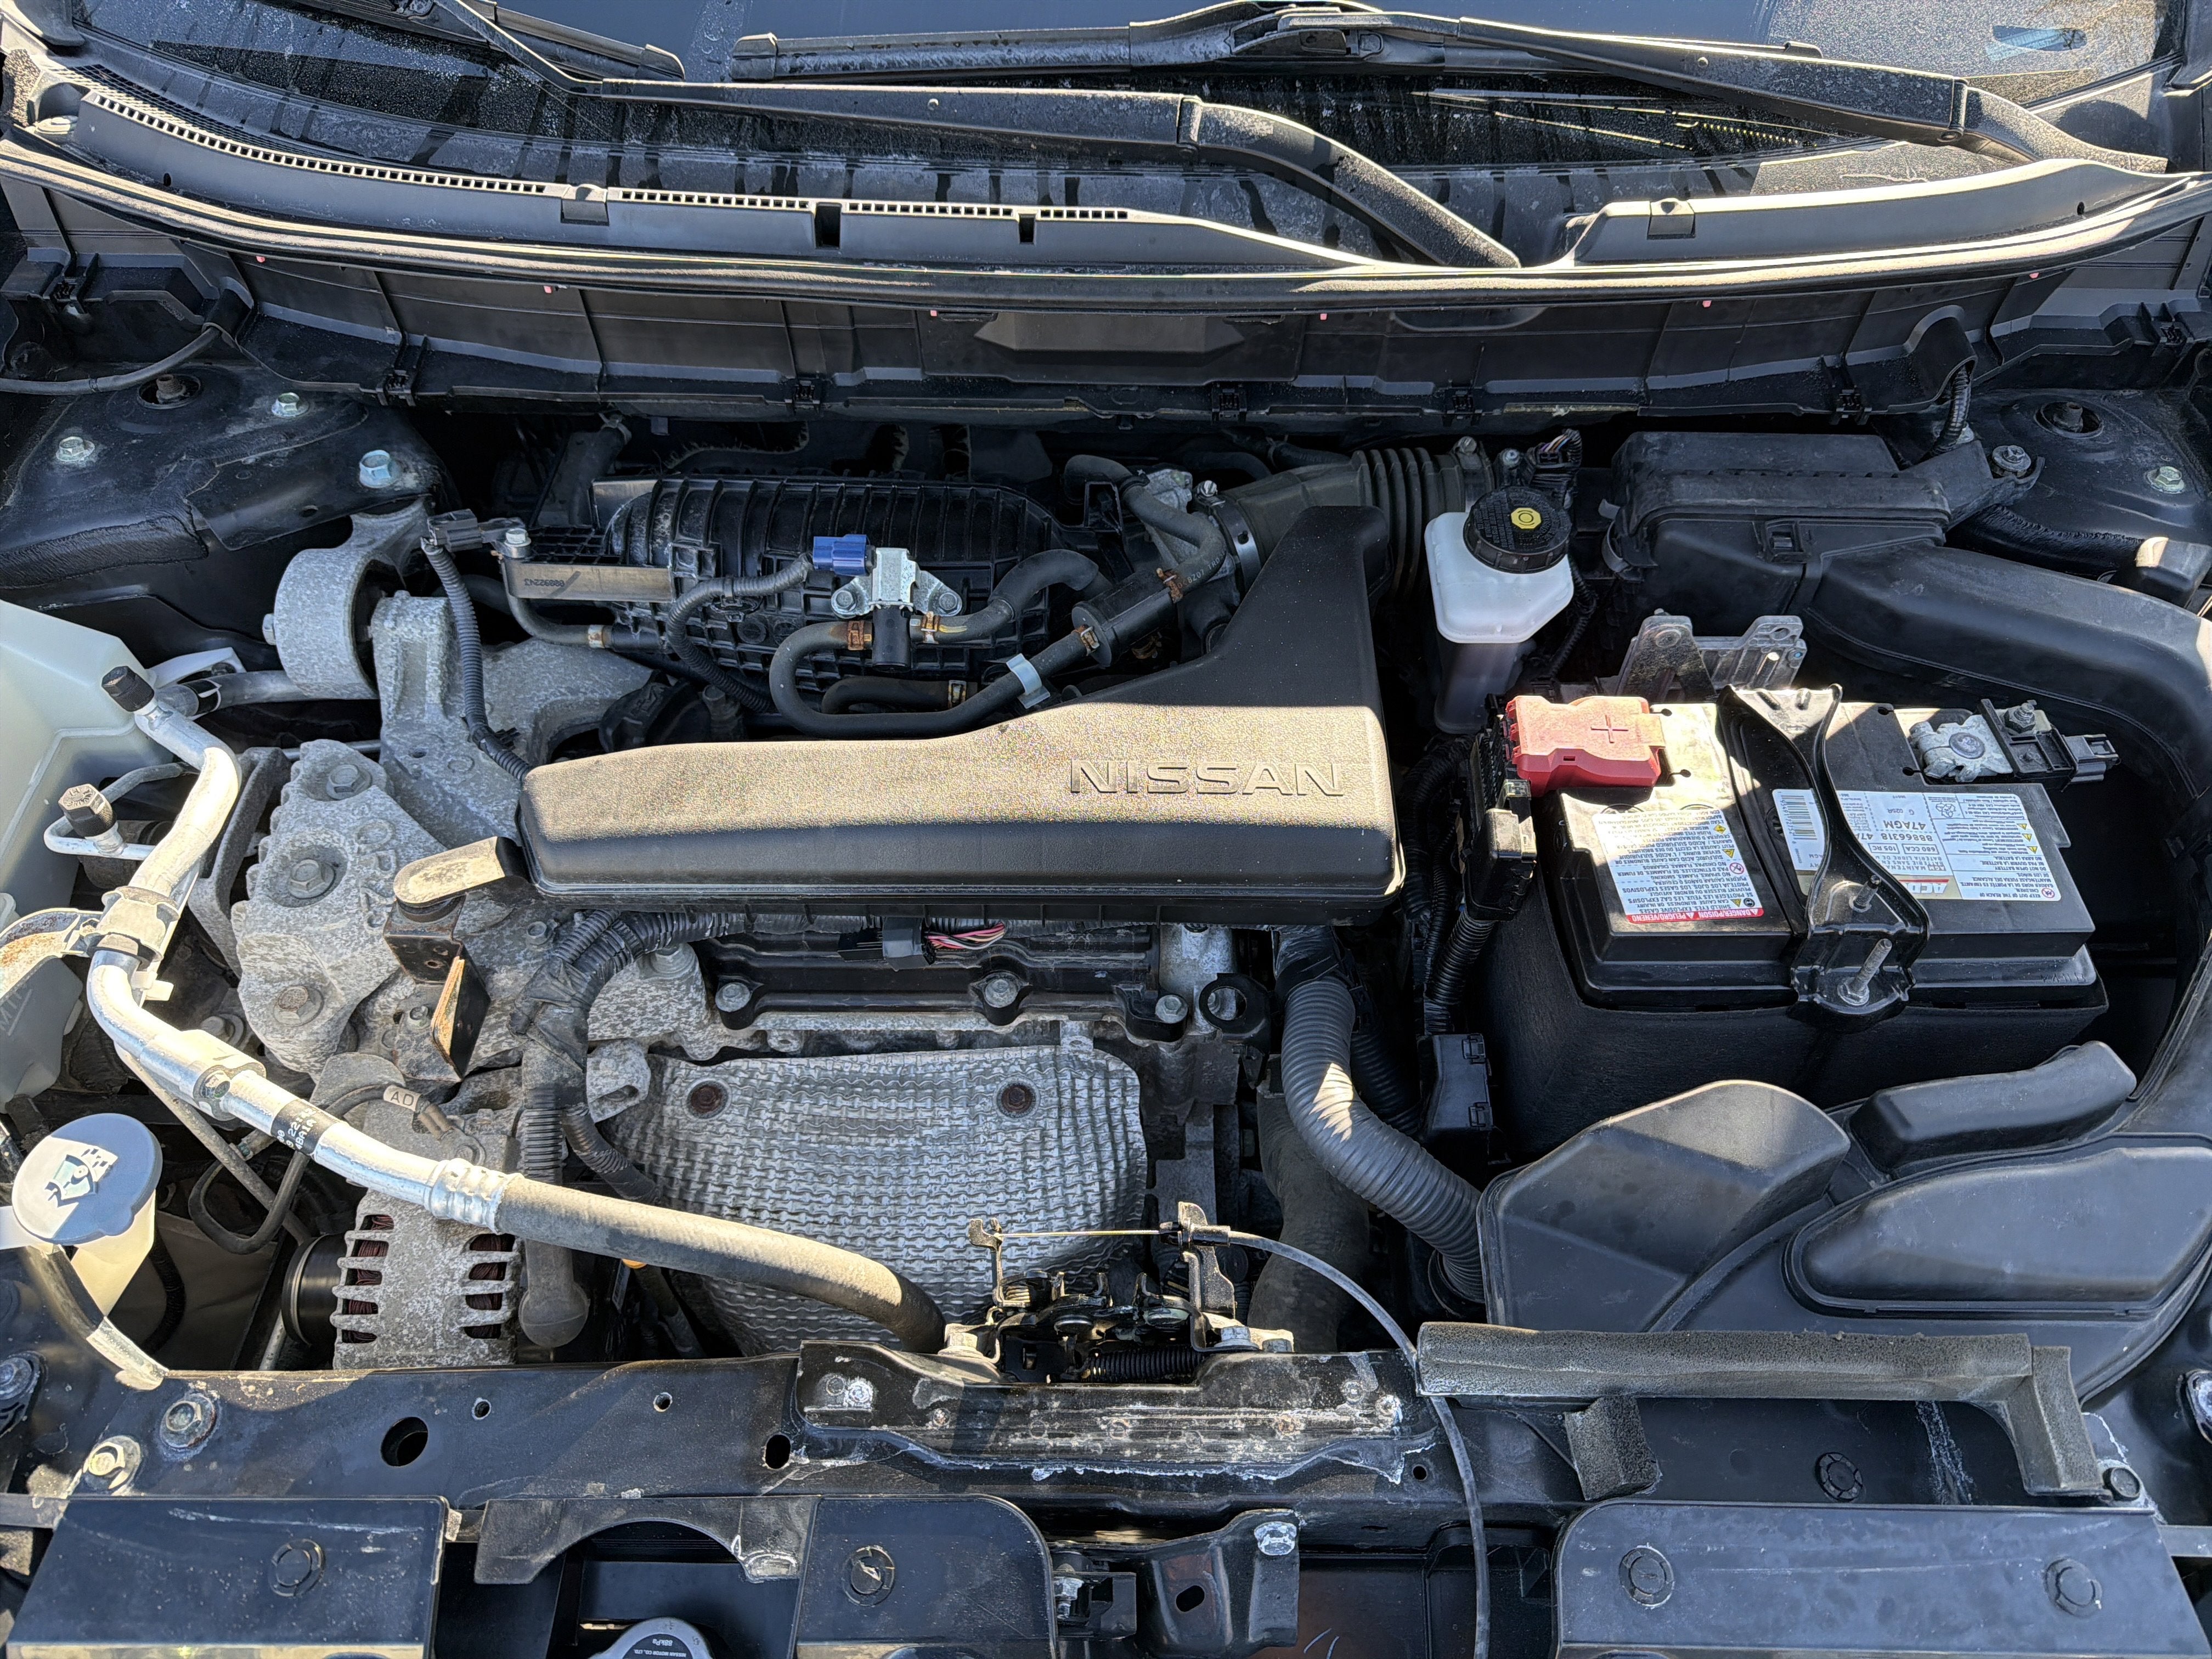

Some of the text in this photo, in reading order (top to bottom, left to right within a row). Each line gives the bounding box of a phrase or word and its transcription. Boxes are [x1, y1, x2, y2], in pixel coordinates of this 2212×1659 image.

[1070, 760, 1344, 795] NISSAN
[1882, 820, 1927, 830] 47AGM
[1906, 883, 1947, 894] ACD
[1630, 908, 1751, 922] DANGER/POISON PELIGRO/VENENO
[390, 1091, 414, 1107] AD
[652, 1638, 673, 1646] 88kPa
